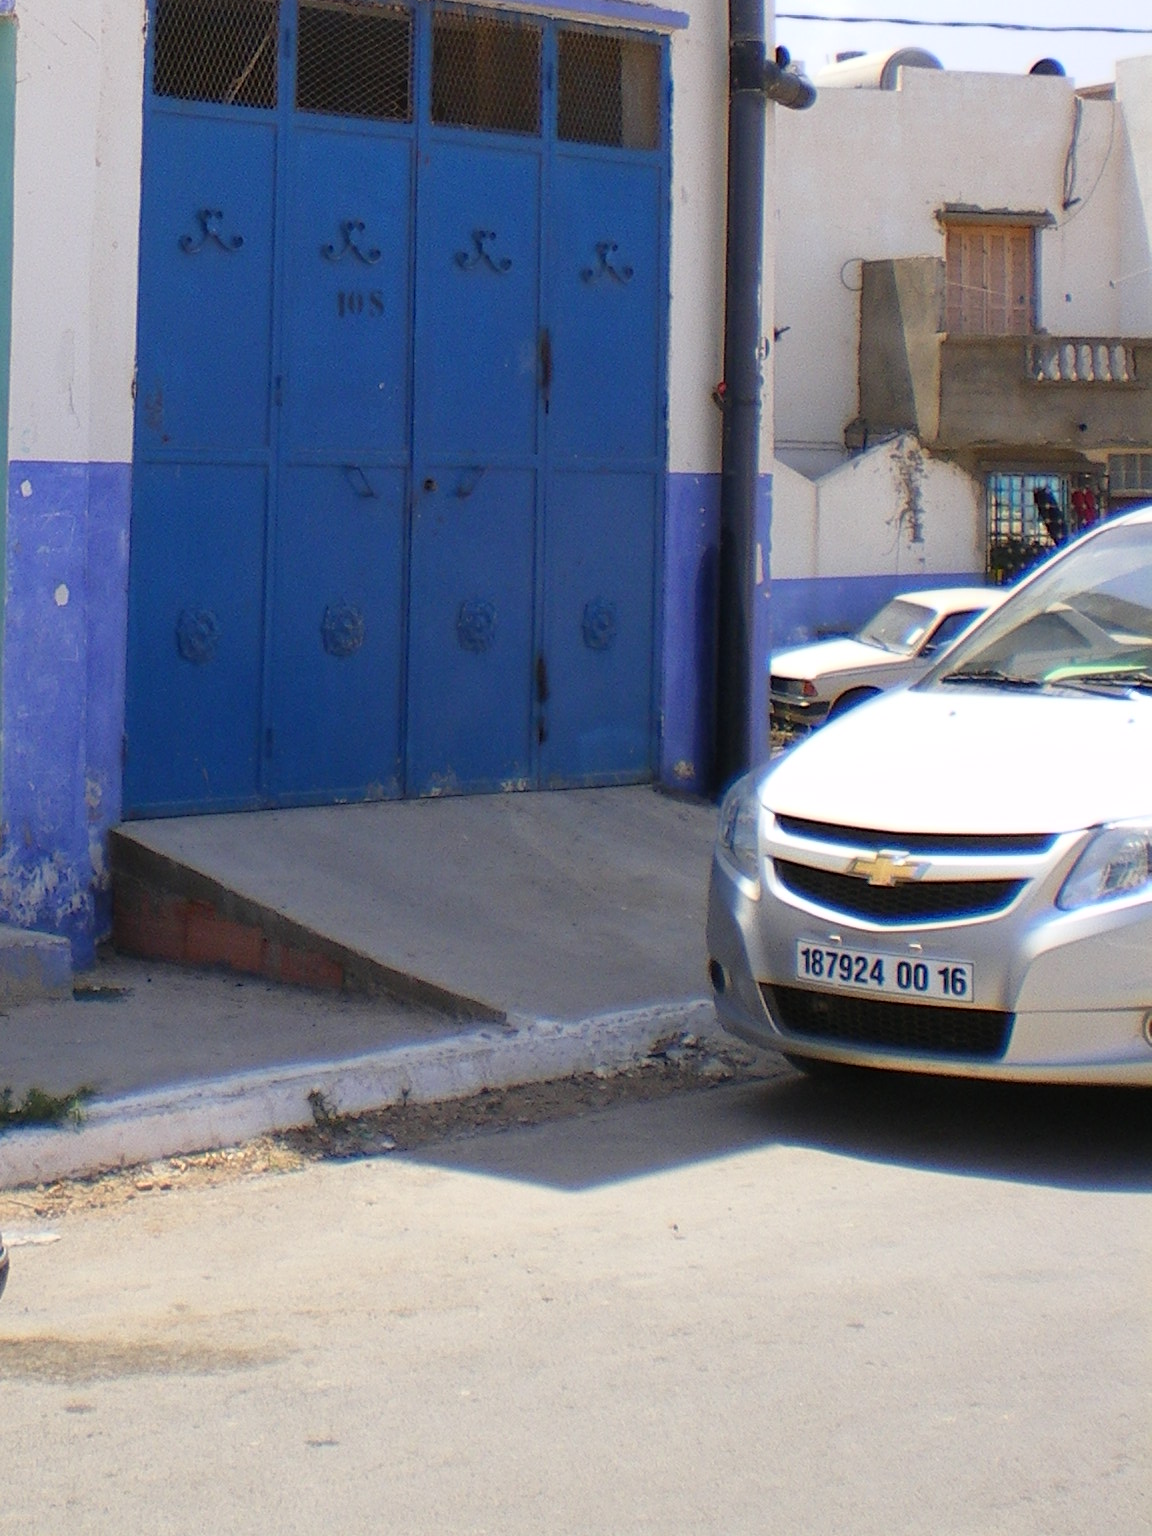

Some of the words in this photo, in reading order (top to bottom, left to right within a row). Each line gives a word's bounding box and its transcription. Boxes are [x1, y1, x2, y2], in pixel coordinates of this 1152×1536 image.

[801, 947, 885, 986] 187924
[897, 961, 928, 991] 00
[938, 967, 967, 995] 16
